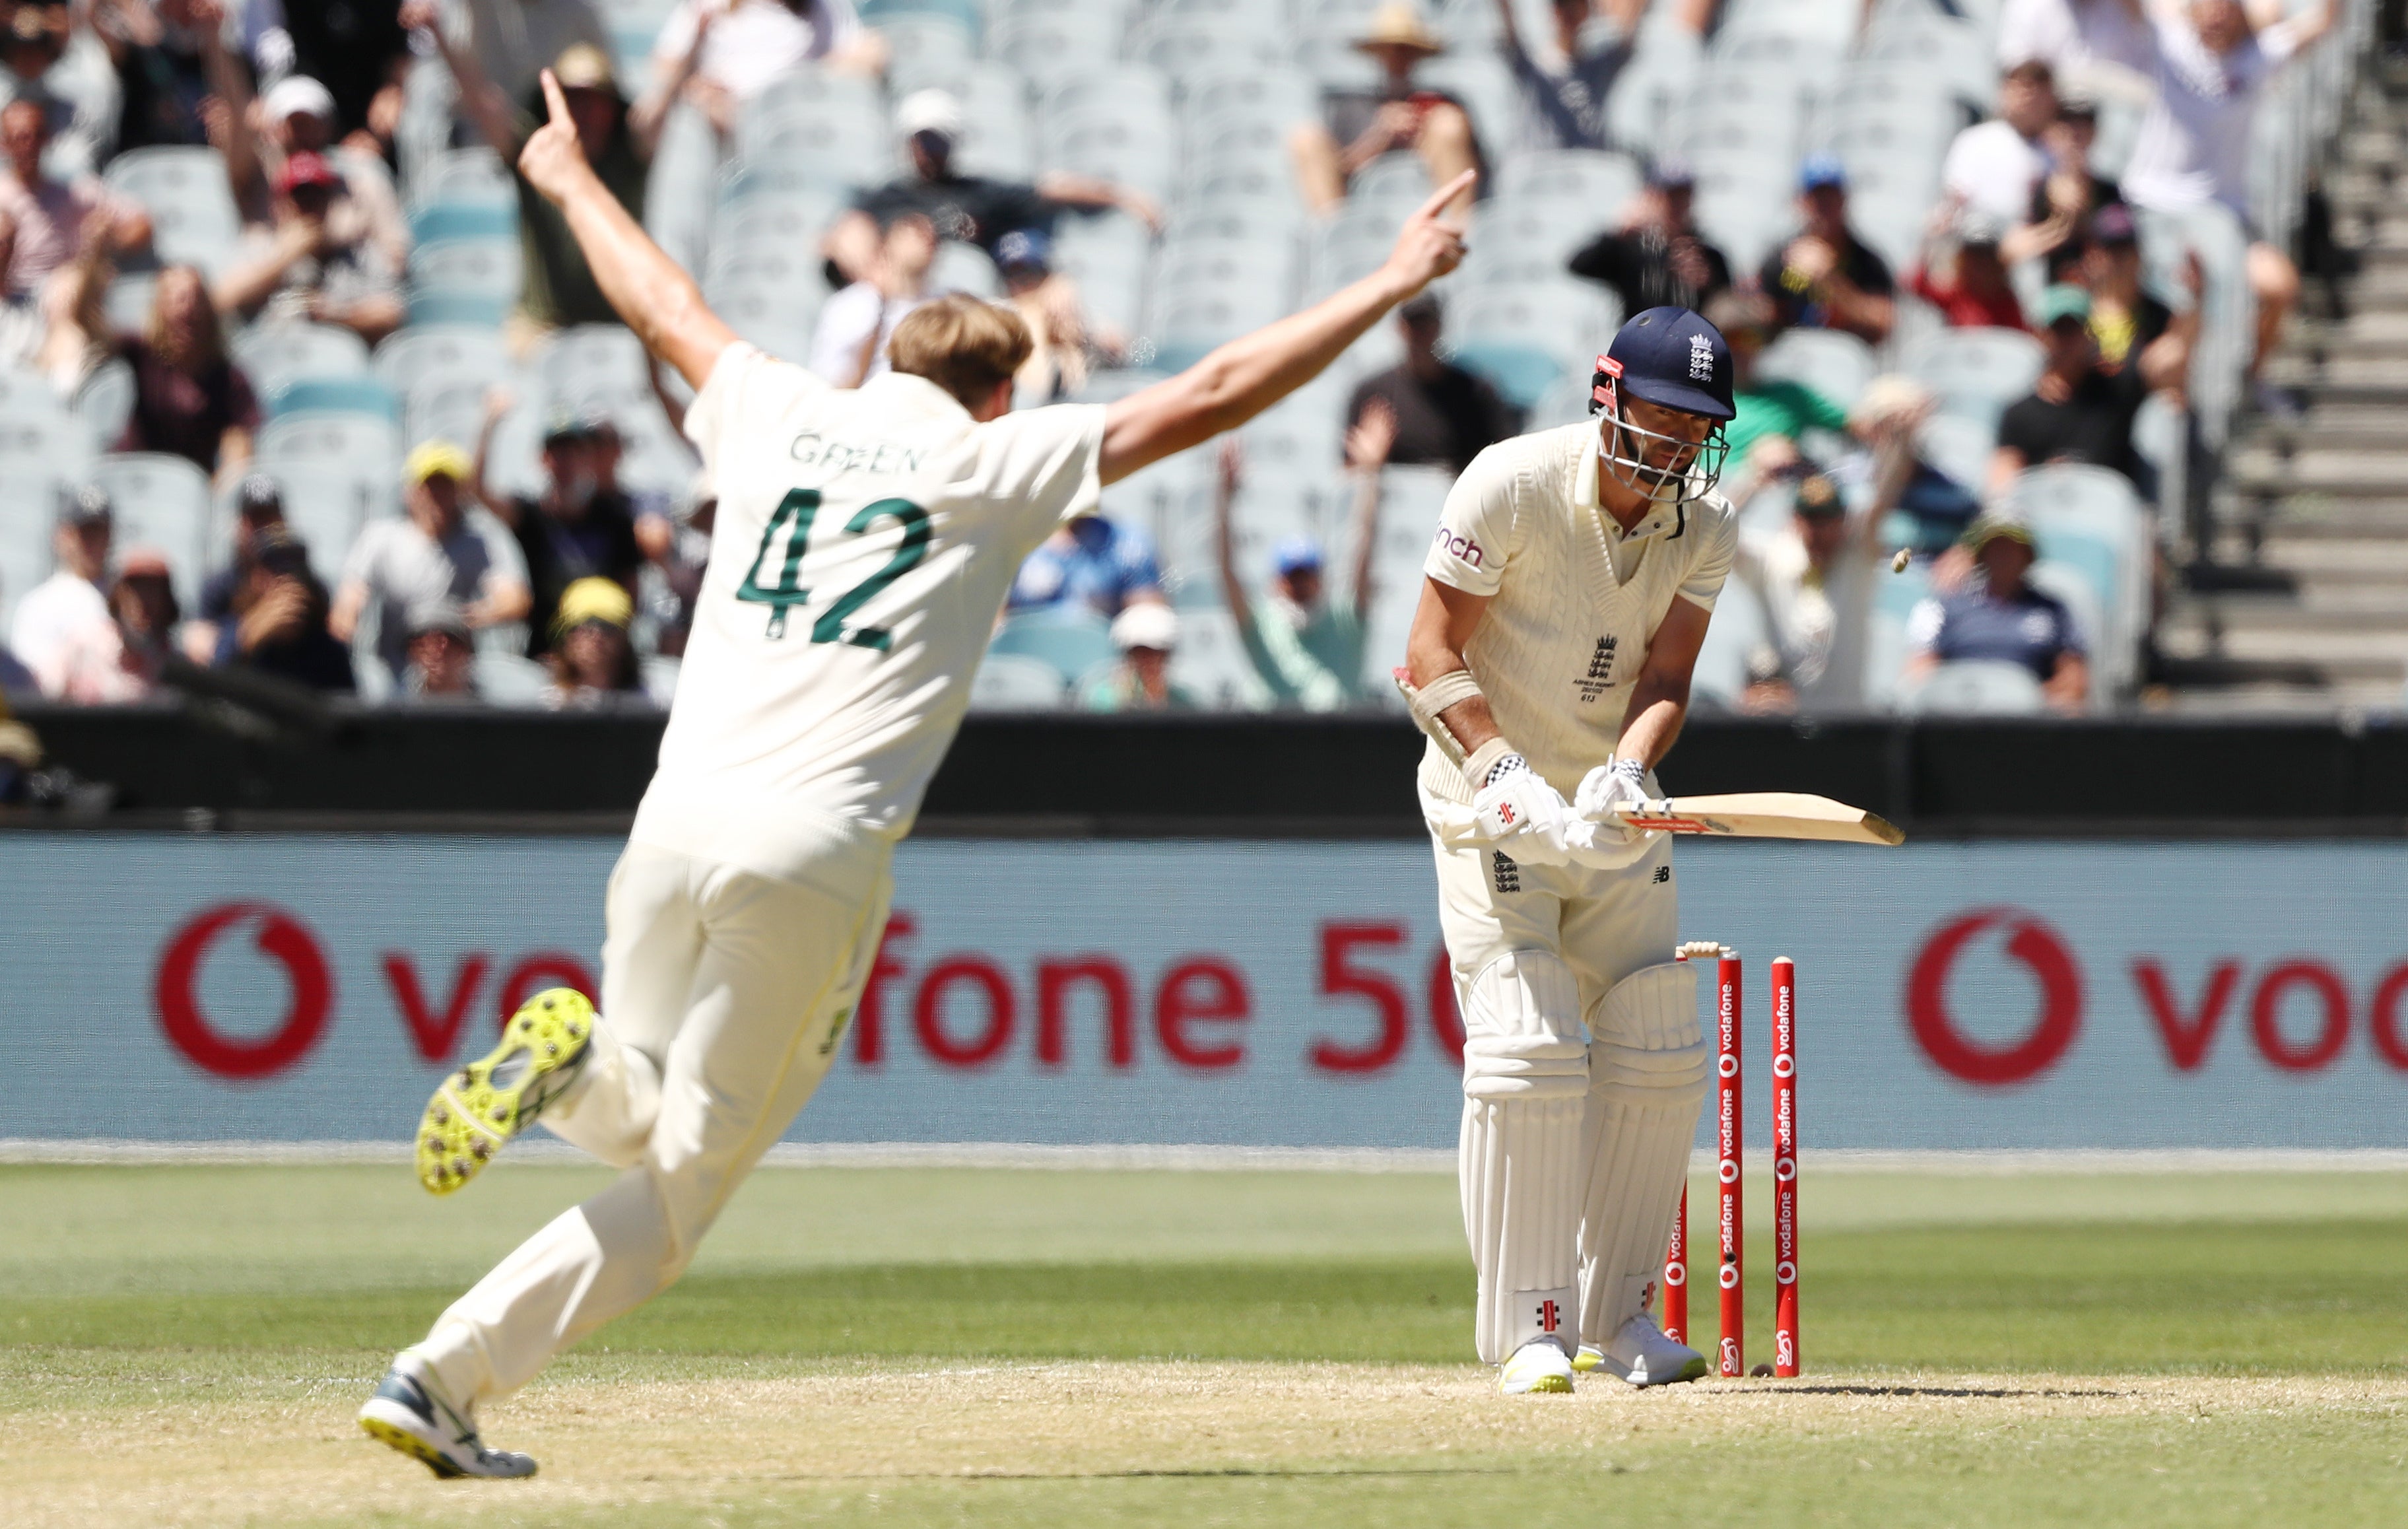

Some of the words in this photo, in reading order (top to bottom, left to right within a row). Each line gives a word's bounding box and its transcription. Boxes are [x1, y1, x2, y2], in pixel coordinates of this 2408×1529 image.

[790, 432, 927, 473] GREEN
[735, 487, 932, 652] 42
[1580, 693, 1596, 702] 613
[1720, 984, 1733, 1052] vodafone
[1776, 985, 1789, 1052] vodafone
[1720, 1089, 1733, 1156] vodafone
[1778, 1089, 1791, 1155] vodafone
[1721, 1194, 1733, 1254] odafone
[1779, 1192, 1791, 1258] vodafone
